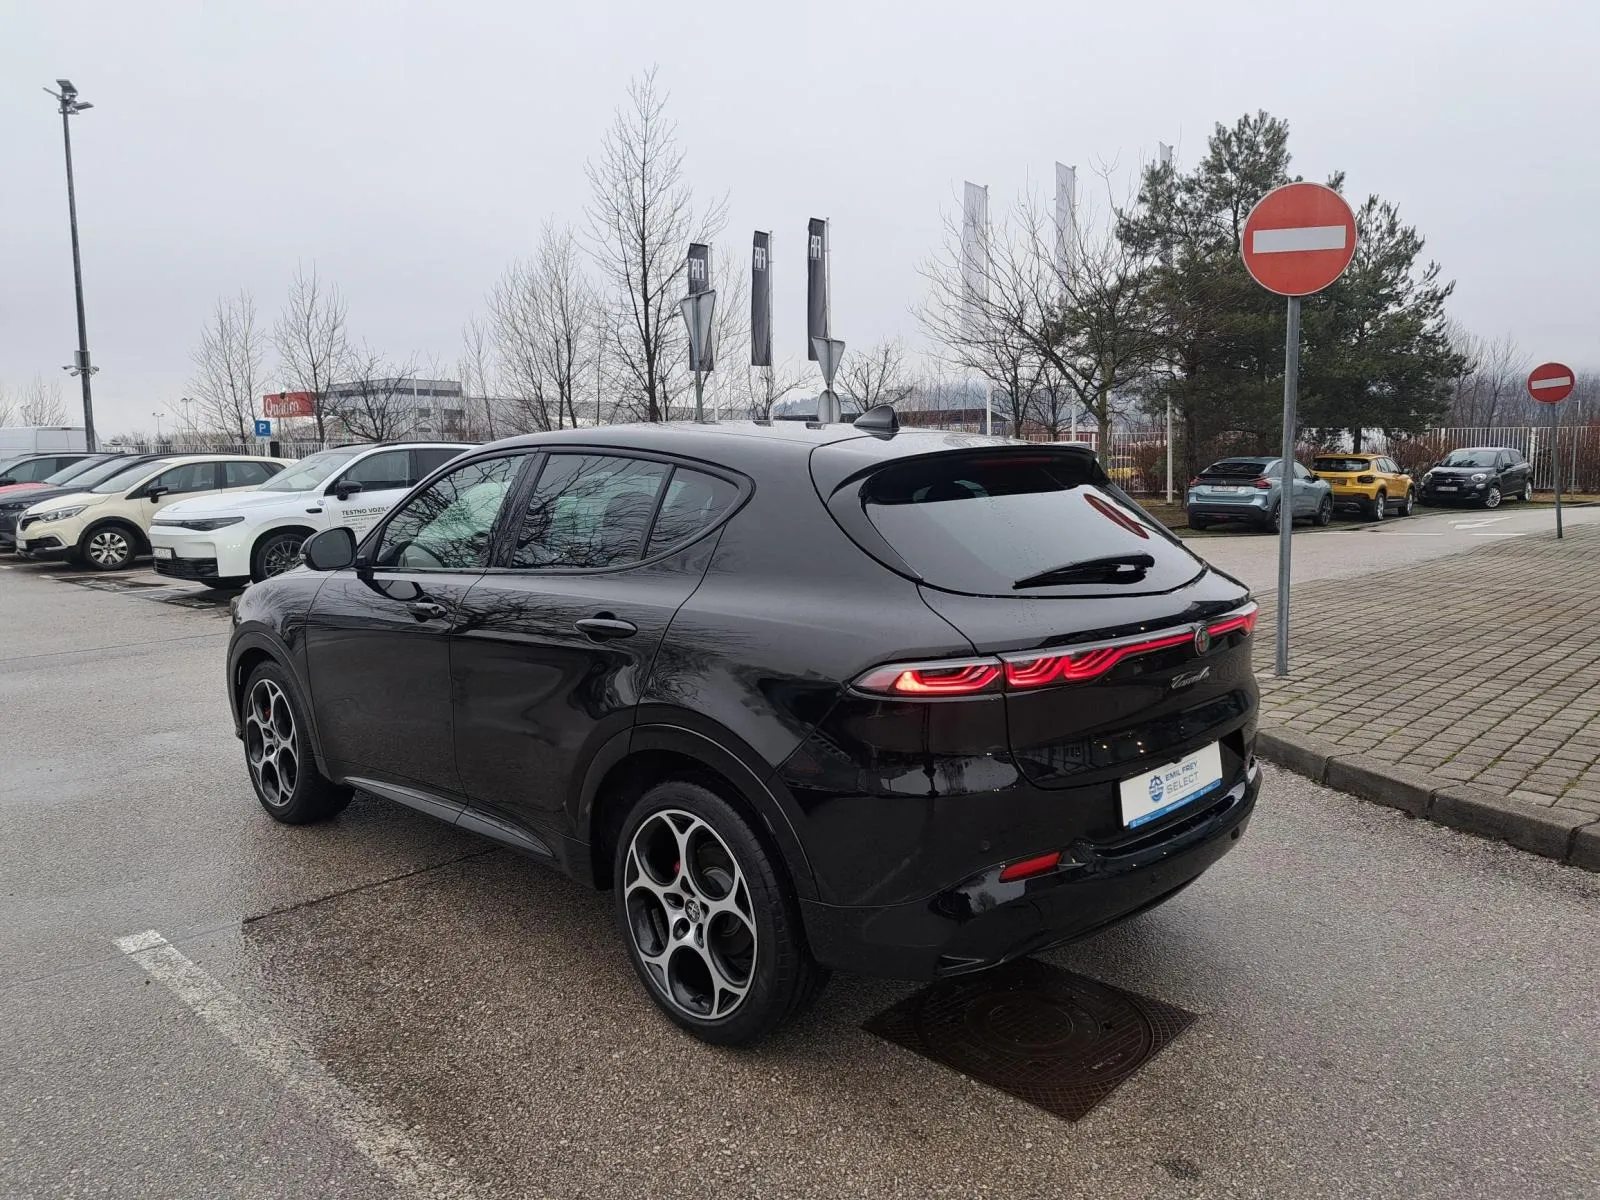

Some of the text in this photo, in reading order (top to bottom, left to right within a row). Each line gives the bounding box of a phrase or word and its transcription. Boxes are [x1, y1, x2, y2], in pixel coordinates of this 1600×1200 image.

[1165, 761, 1198, 782] EMIL FREY
[1166, 771, 1200, 795] SELECT
